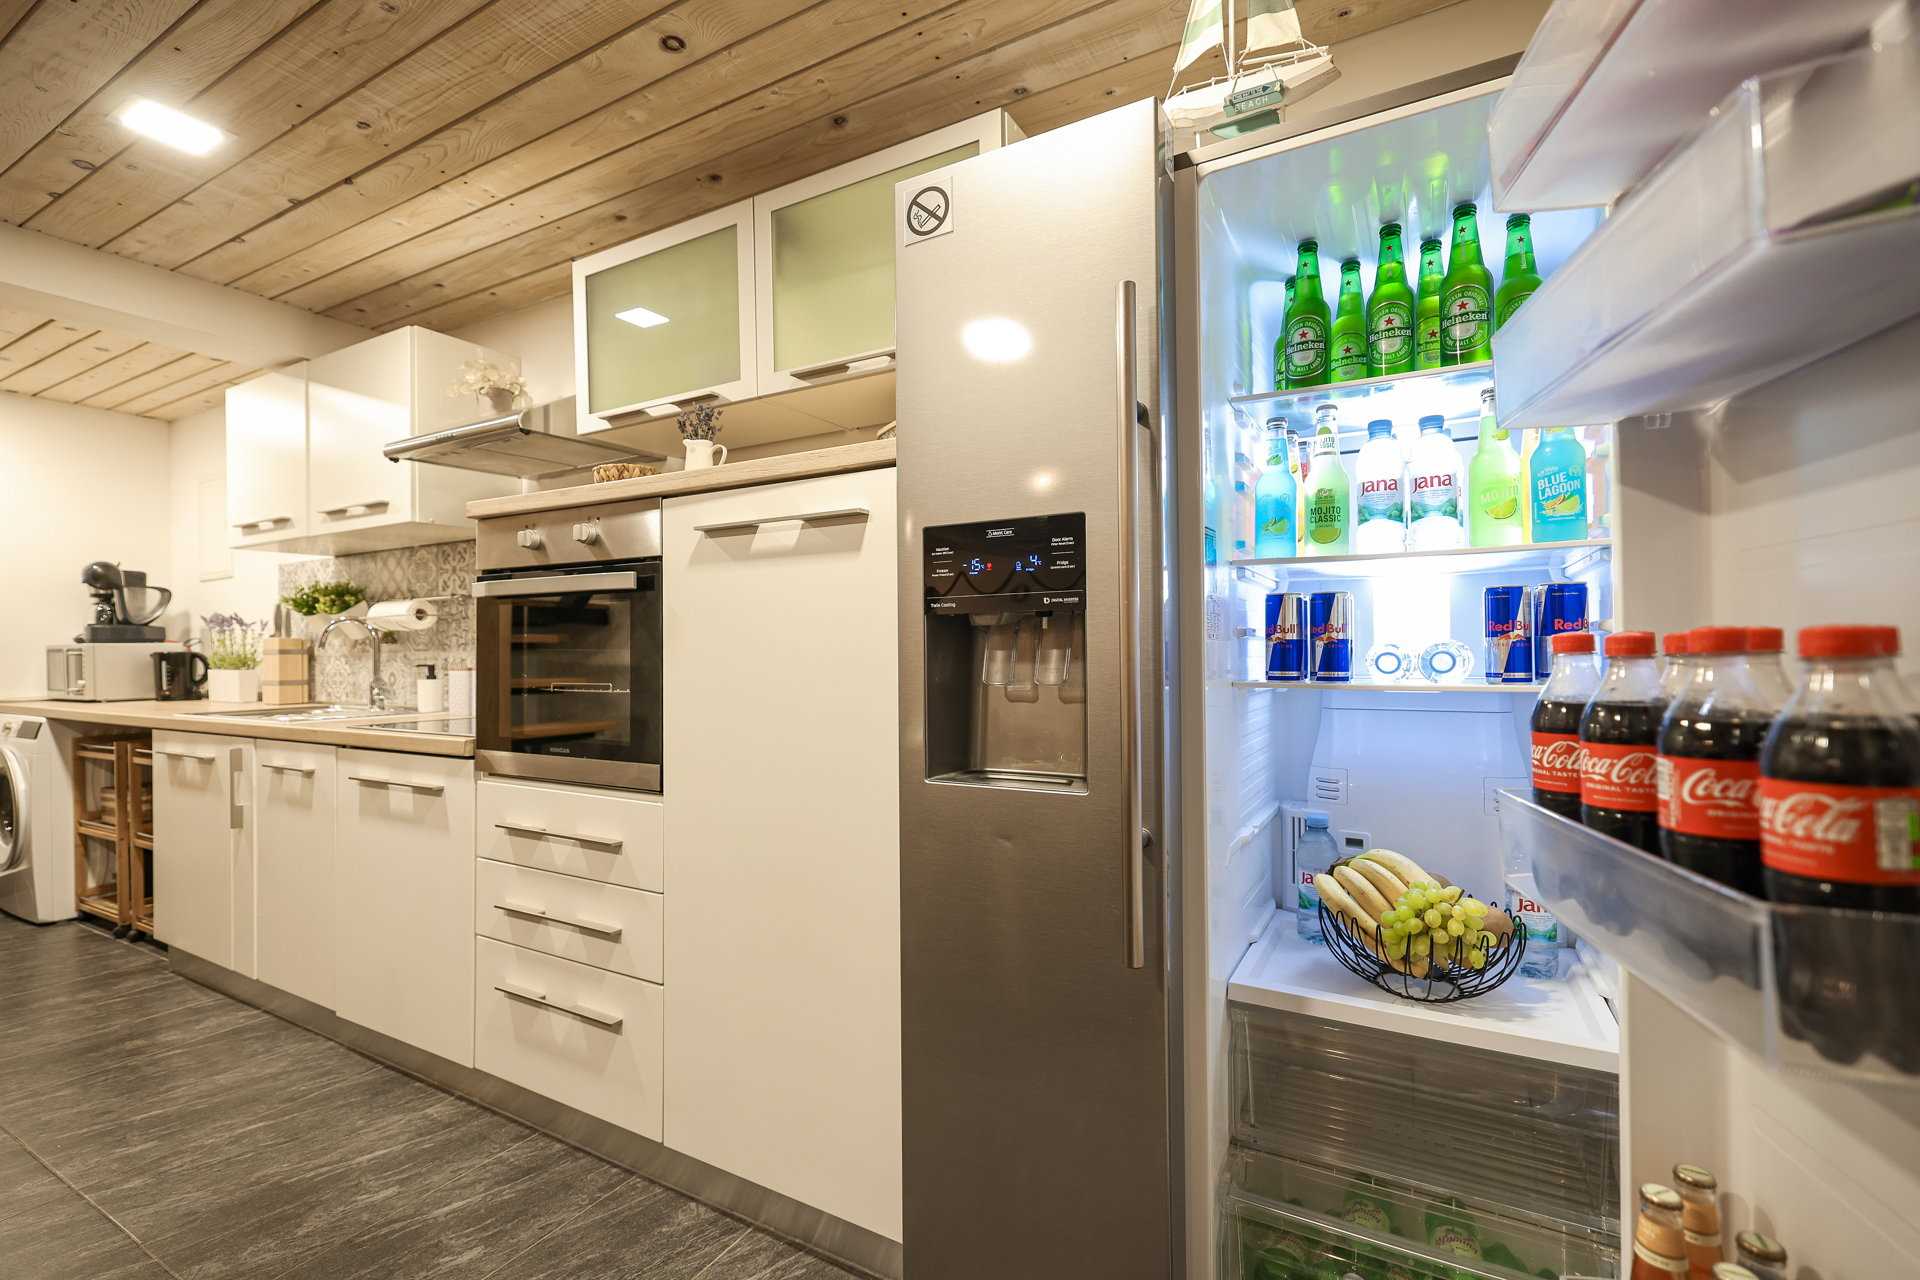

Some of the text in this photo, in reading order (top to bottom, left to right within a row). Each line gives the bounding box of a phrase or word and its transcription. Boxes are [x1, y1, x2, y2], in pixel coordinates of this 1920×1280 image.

[1234, 95, 1268, 112] BEACH
[1442, 311, 1488, 329] Heineken
[1369, 328, 1412, 343] Heineken
[1537, 471, 1568, 490] BLUE
[1538, 479, 1581, 500] LAGOON
[1310, 505, 1341, 516] MOJITO
[1310, 514, 1342, 524] CLASSIC
[1275, 623, 1297, 634] Bull
[1488, 619, 1513, 632] Red
[1554, 618, 1582, 631] Red
